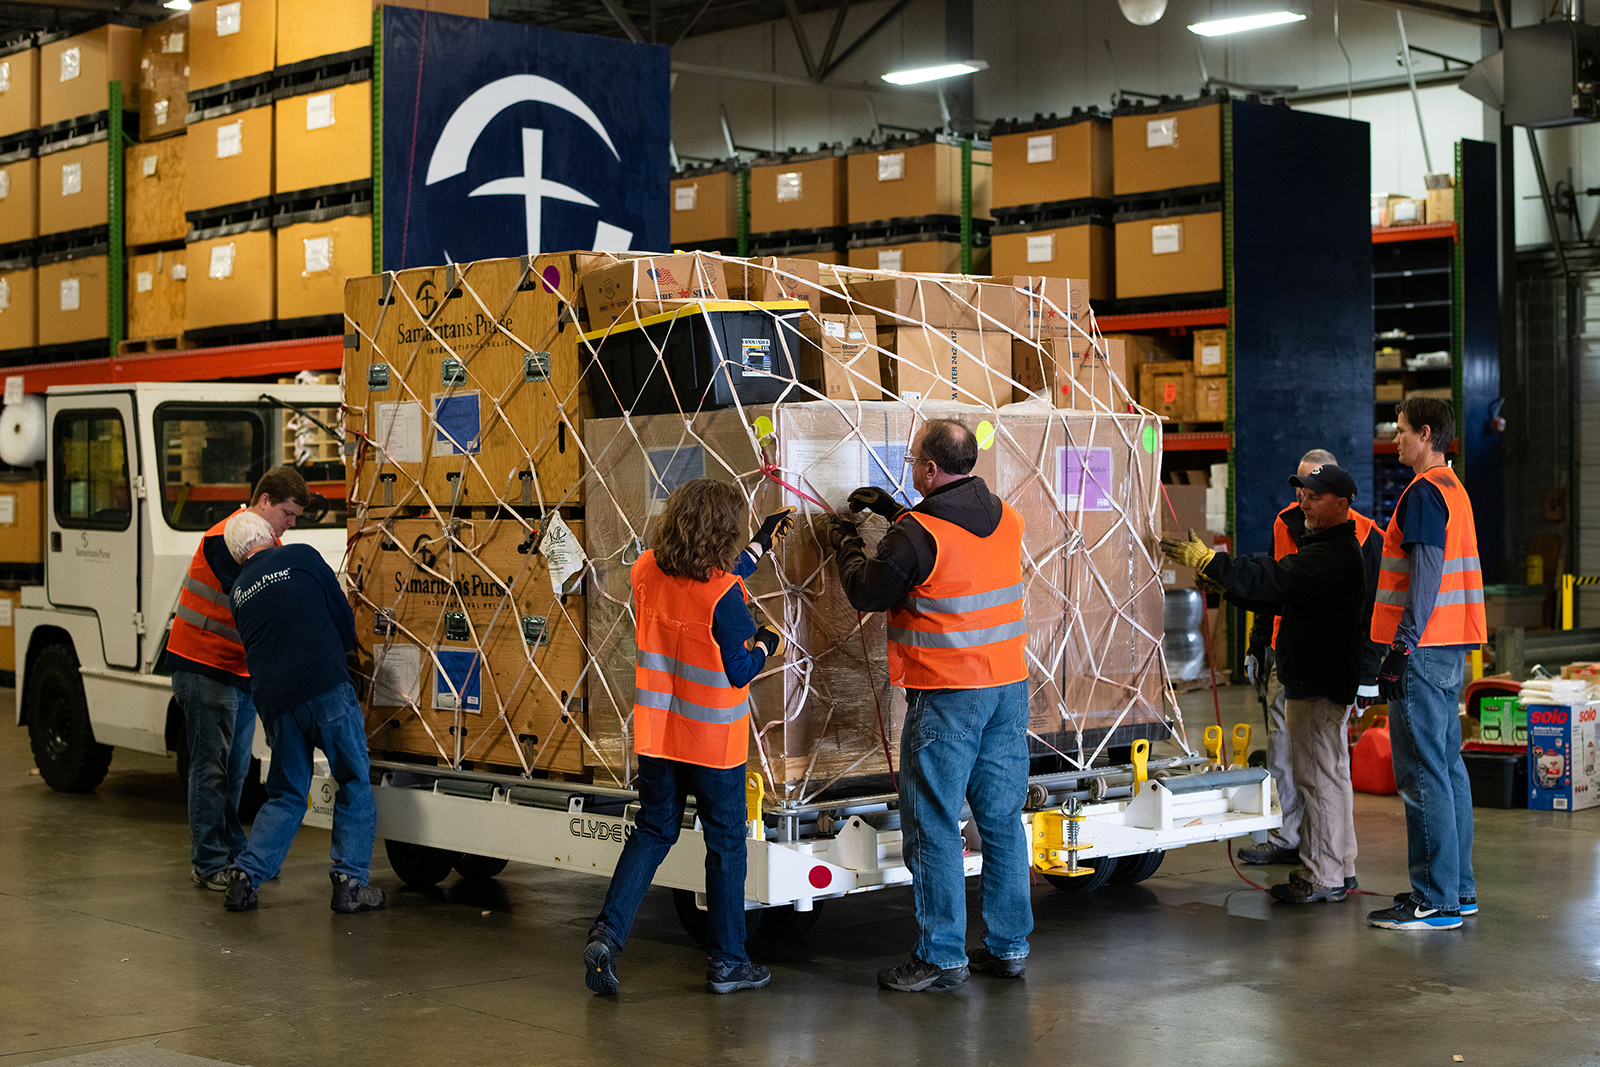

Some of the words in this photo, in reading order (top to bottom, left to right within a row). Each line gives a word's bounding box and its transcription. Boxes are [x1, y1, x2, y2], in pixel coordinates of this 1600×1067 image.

[262, 568, 289, 584] Purse
[394, 571, 470, 597] Samaritan's
[1530, 708, 1568, 724] solo
[1578, 706, 1597, 723] solo
[312, 802, 333, 815] Samar
